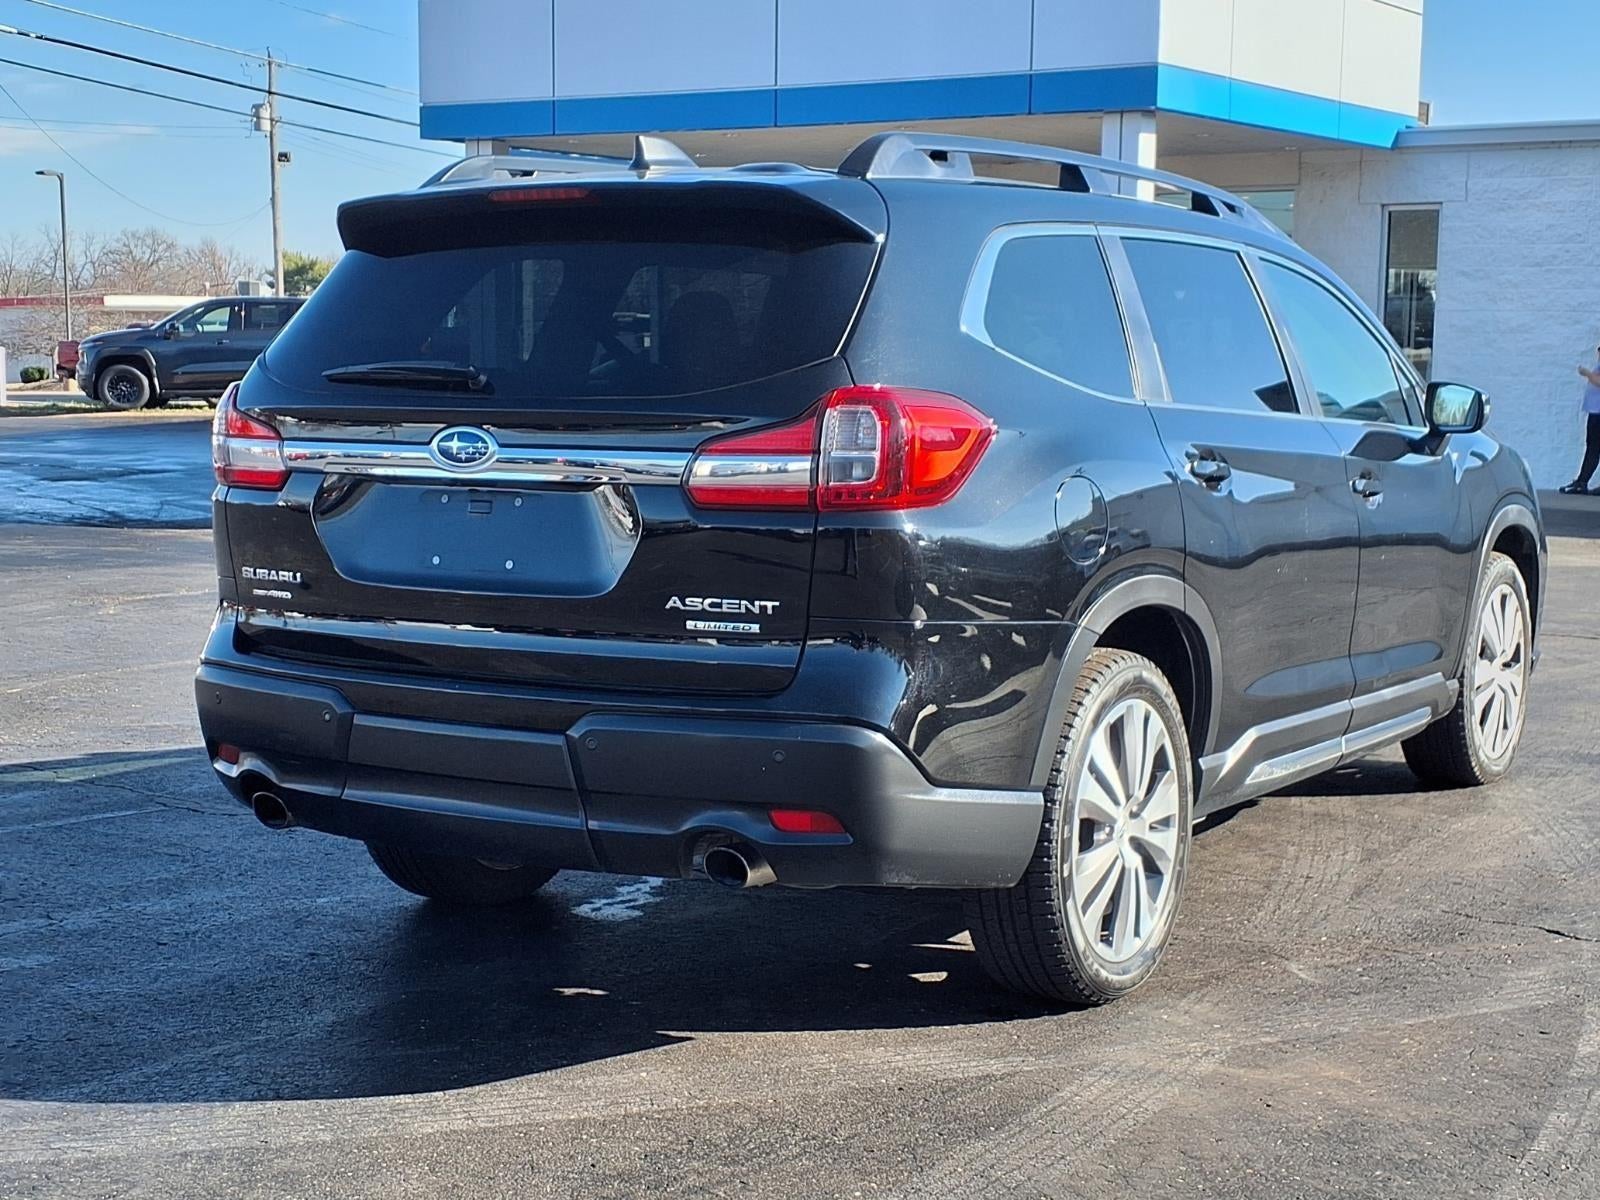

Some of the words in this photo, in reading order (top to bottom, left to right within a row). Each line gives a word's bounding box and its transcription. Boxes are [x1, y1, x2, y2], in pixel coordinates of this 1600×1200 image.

[241, 566, 301, 583] SUBARU
[664, 596, 780, 615] ASCENT
[693, 621, 752, 632] LIMITED
